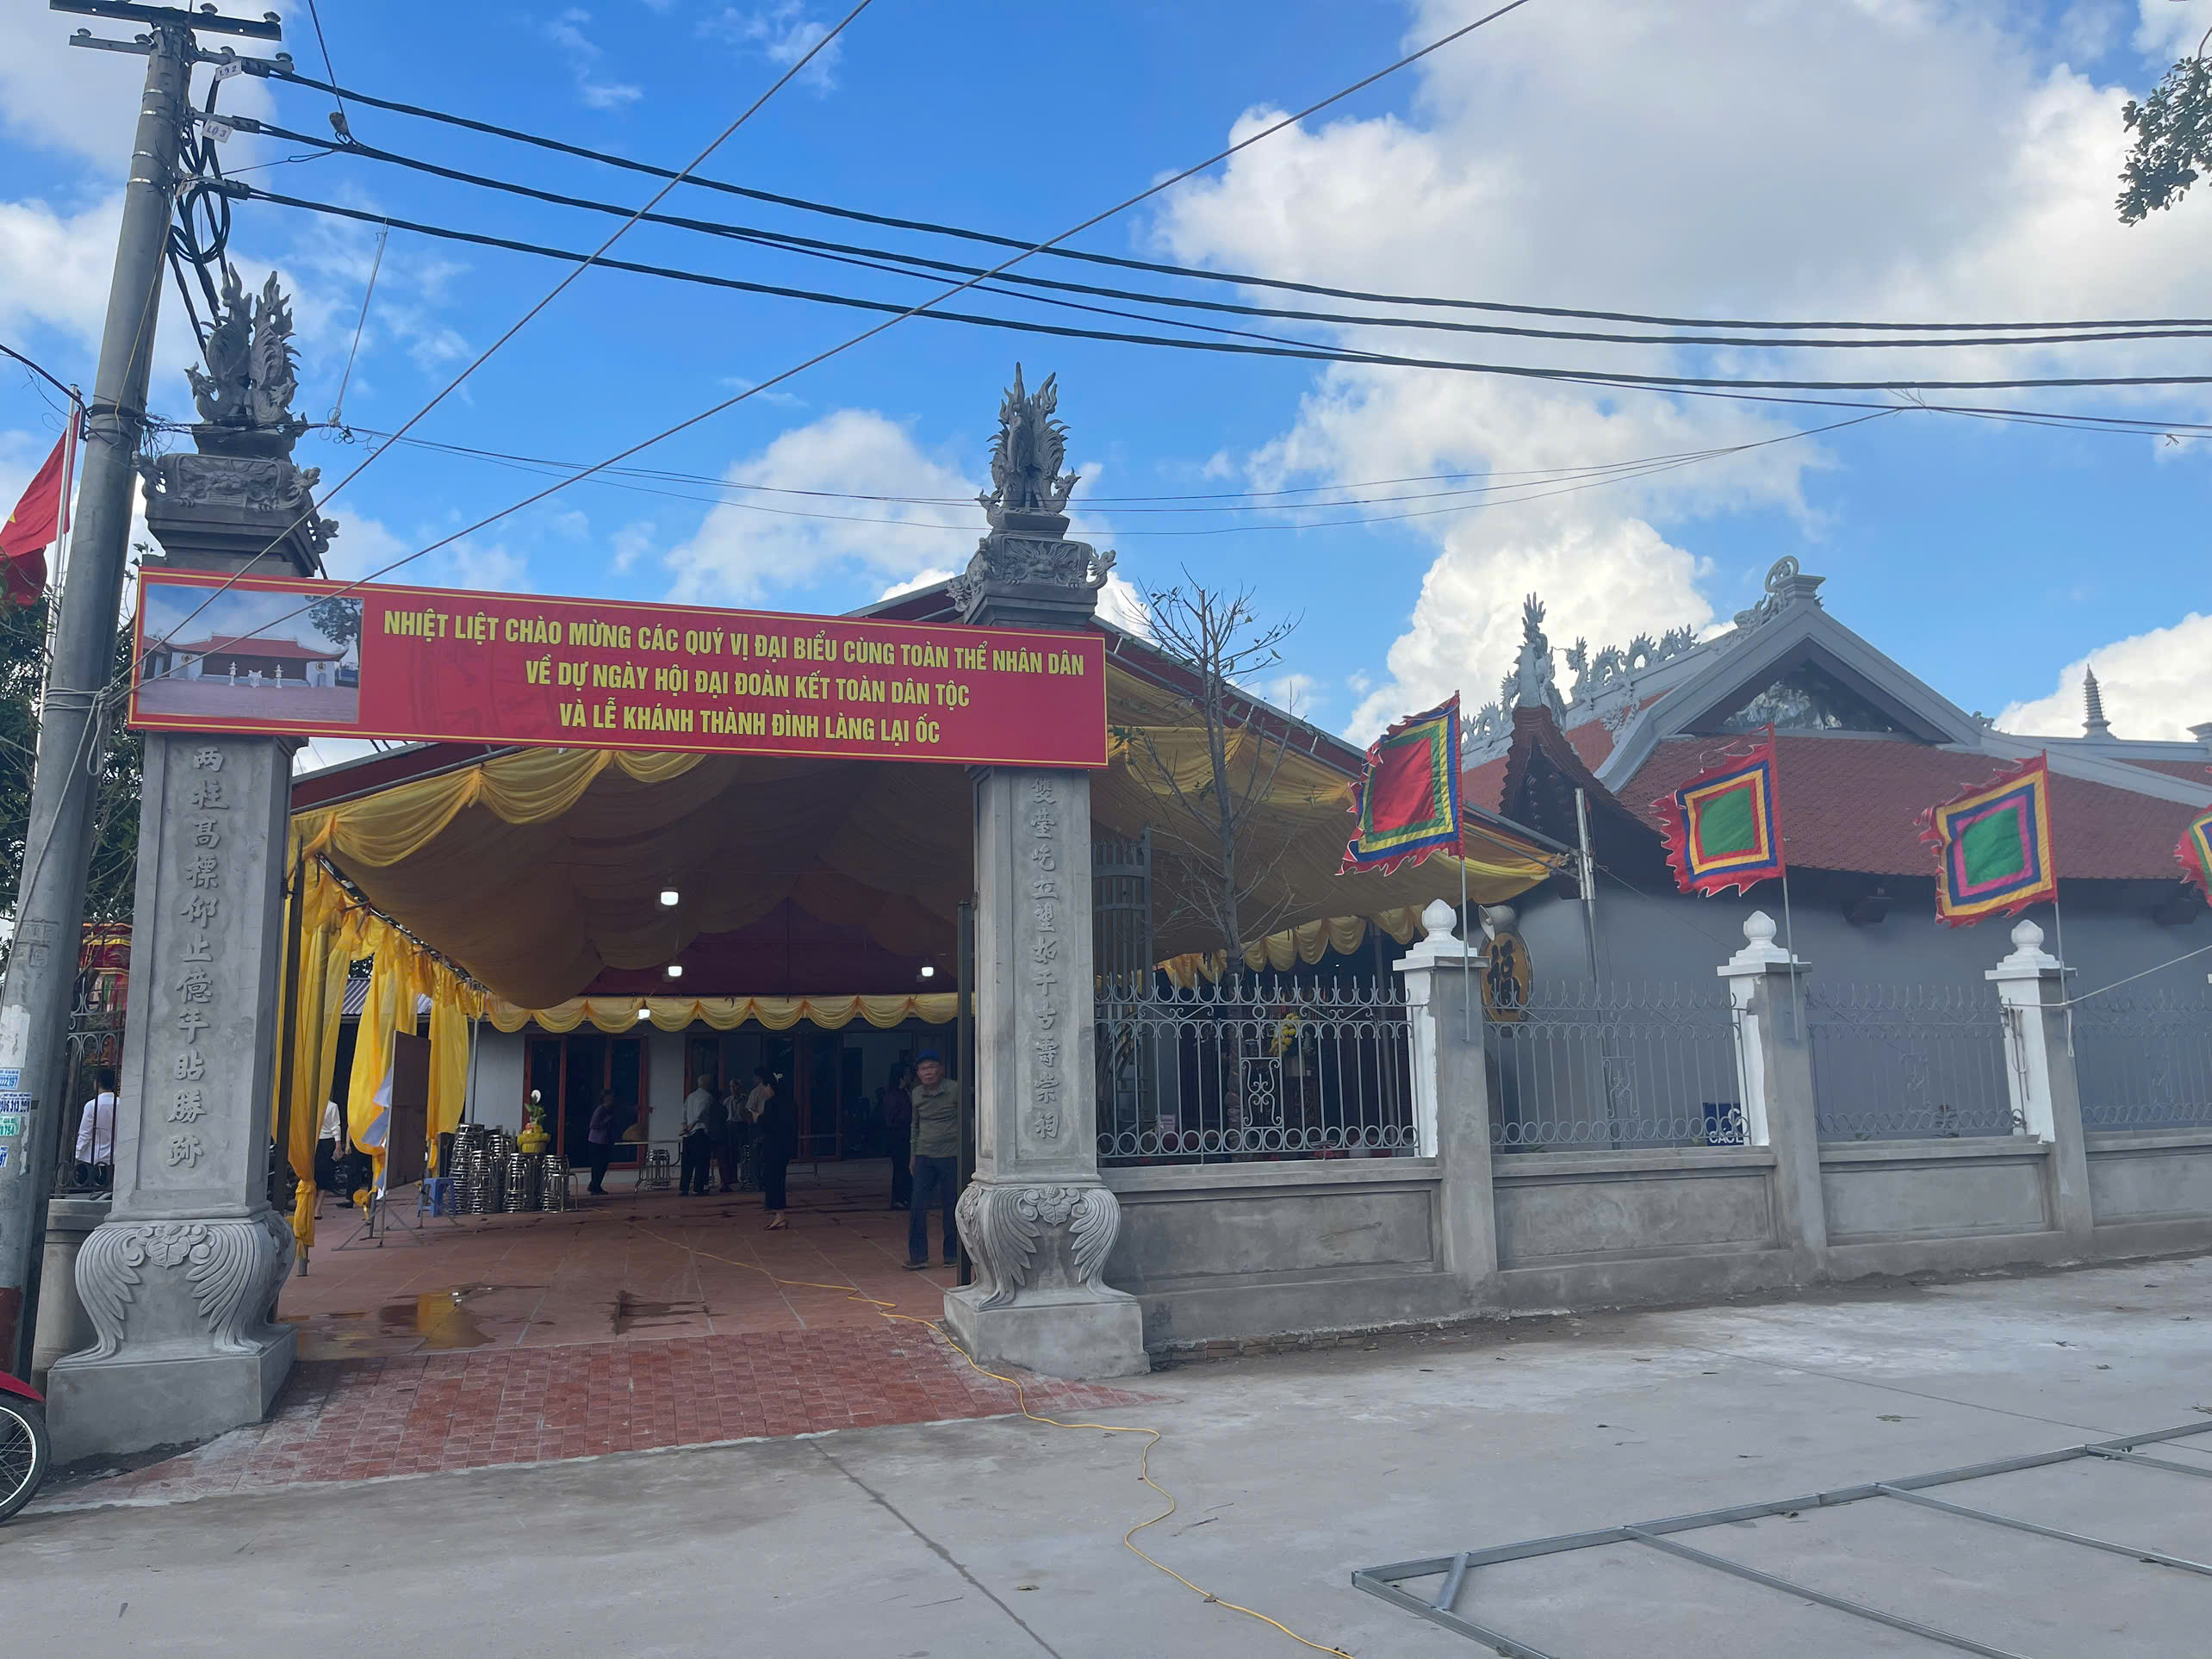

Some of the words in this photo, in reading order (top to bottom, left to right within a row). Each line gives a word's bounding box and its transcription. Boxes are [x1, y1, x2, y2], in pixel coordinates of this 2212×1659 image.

[231, 65, 237, 73] 2
[220, 129, 227, 138] 3
[383, 608, 449, 643] NHIỆT
[454, 611, 500, 645] LIỆT
[505, 615, 562, 645] CHÀO
[569, 619, 631, 649] MỪNG
[637, 624, 679, 652] CÁC
[685, 626, 724, 656] QUÝ
[730, 633, 749, 662] VỊ
[755, 634, 787, 662] ĐẠI
[793, 630, 837, 662] BIỂU
[843, 638, 895, 665] CÙNG
[900, 642, 949, 668] TOÀN
[954, 640, 986, 670] THỂ
[992, 647, 1043, 674] NHÂN
[1047, 649, 1084, 676] DÂN
[525, 649, 553, 685] VỀ
[557, 661, 589, 692] DỰ
[593, 661, 649, 690] NGÀY
[655, 664, 689, 697] HỘI
[694, 670, 729, 699] ĐẠI
[734, 670, 789, 697] ĐOÀN
[795, 668, 830, 699] KẾT
[835, 674, 885, 703] TOÀN
[891, 678, 930, 705] DÂN
[935, 680, 970, 711] TỘC
[559, 699, 587, 728] VÀ
[593, 694, 617, 729] LỄ
[623, 703, 693, 732] KHÁNH
[699, 706, 766, 736] THÀNH
[771, 709, 819, 738] ĐÌNH
[825, 712, 875, 741] LÀNG
[881, 718, 910, 747] LẠI
[916, 713, 940, 743] ỐC
